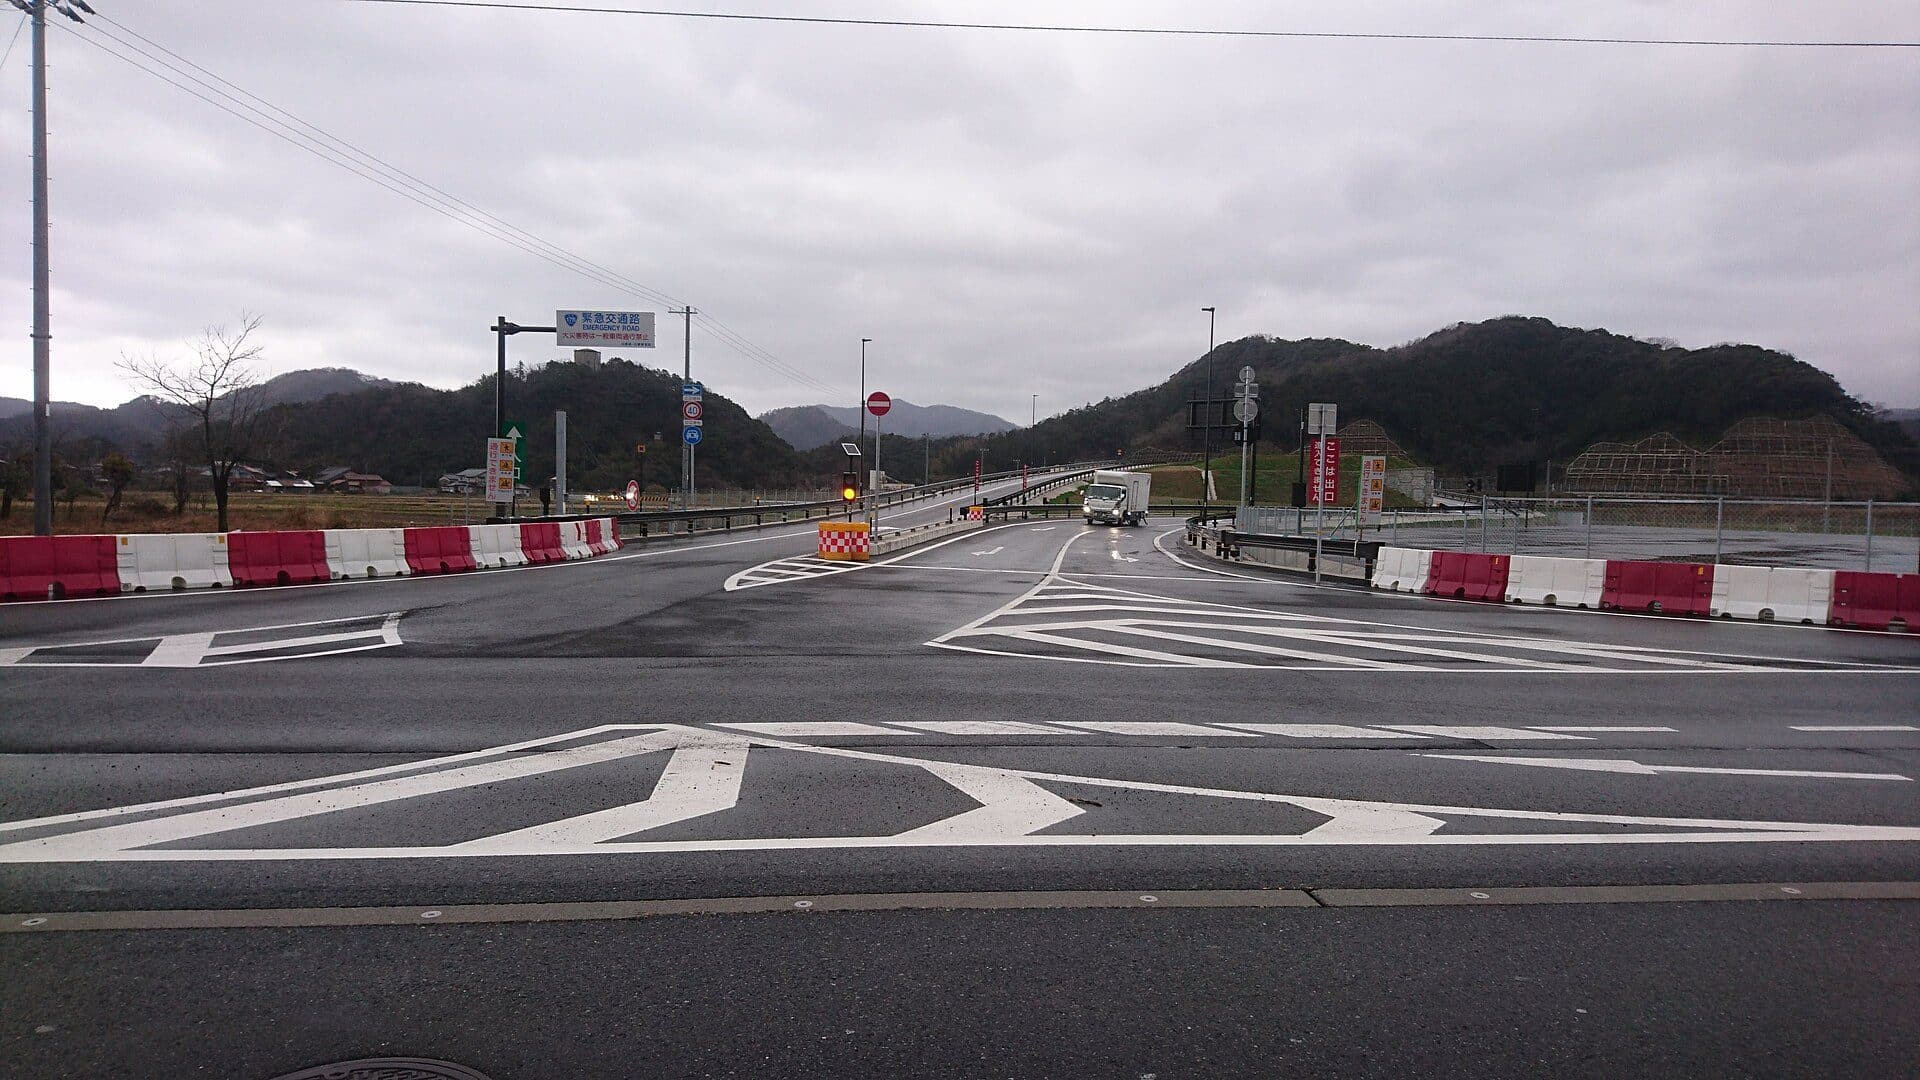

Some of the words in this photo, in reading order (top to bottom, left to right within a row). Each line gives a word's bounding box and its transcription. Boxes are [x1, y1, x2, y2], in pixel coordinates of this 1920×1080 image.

[582, 312, 640, 325] 緊急交通路
[688, 406, 698, 415] 40
[488, 442, 499, 500] 通行できません
[1324, 441, 1336, 502] ここは出口
[1360, 460, 1372, 523] 通行できません
